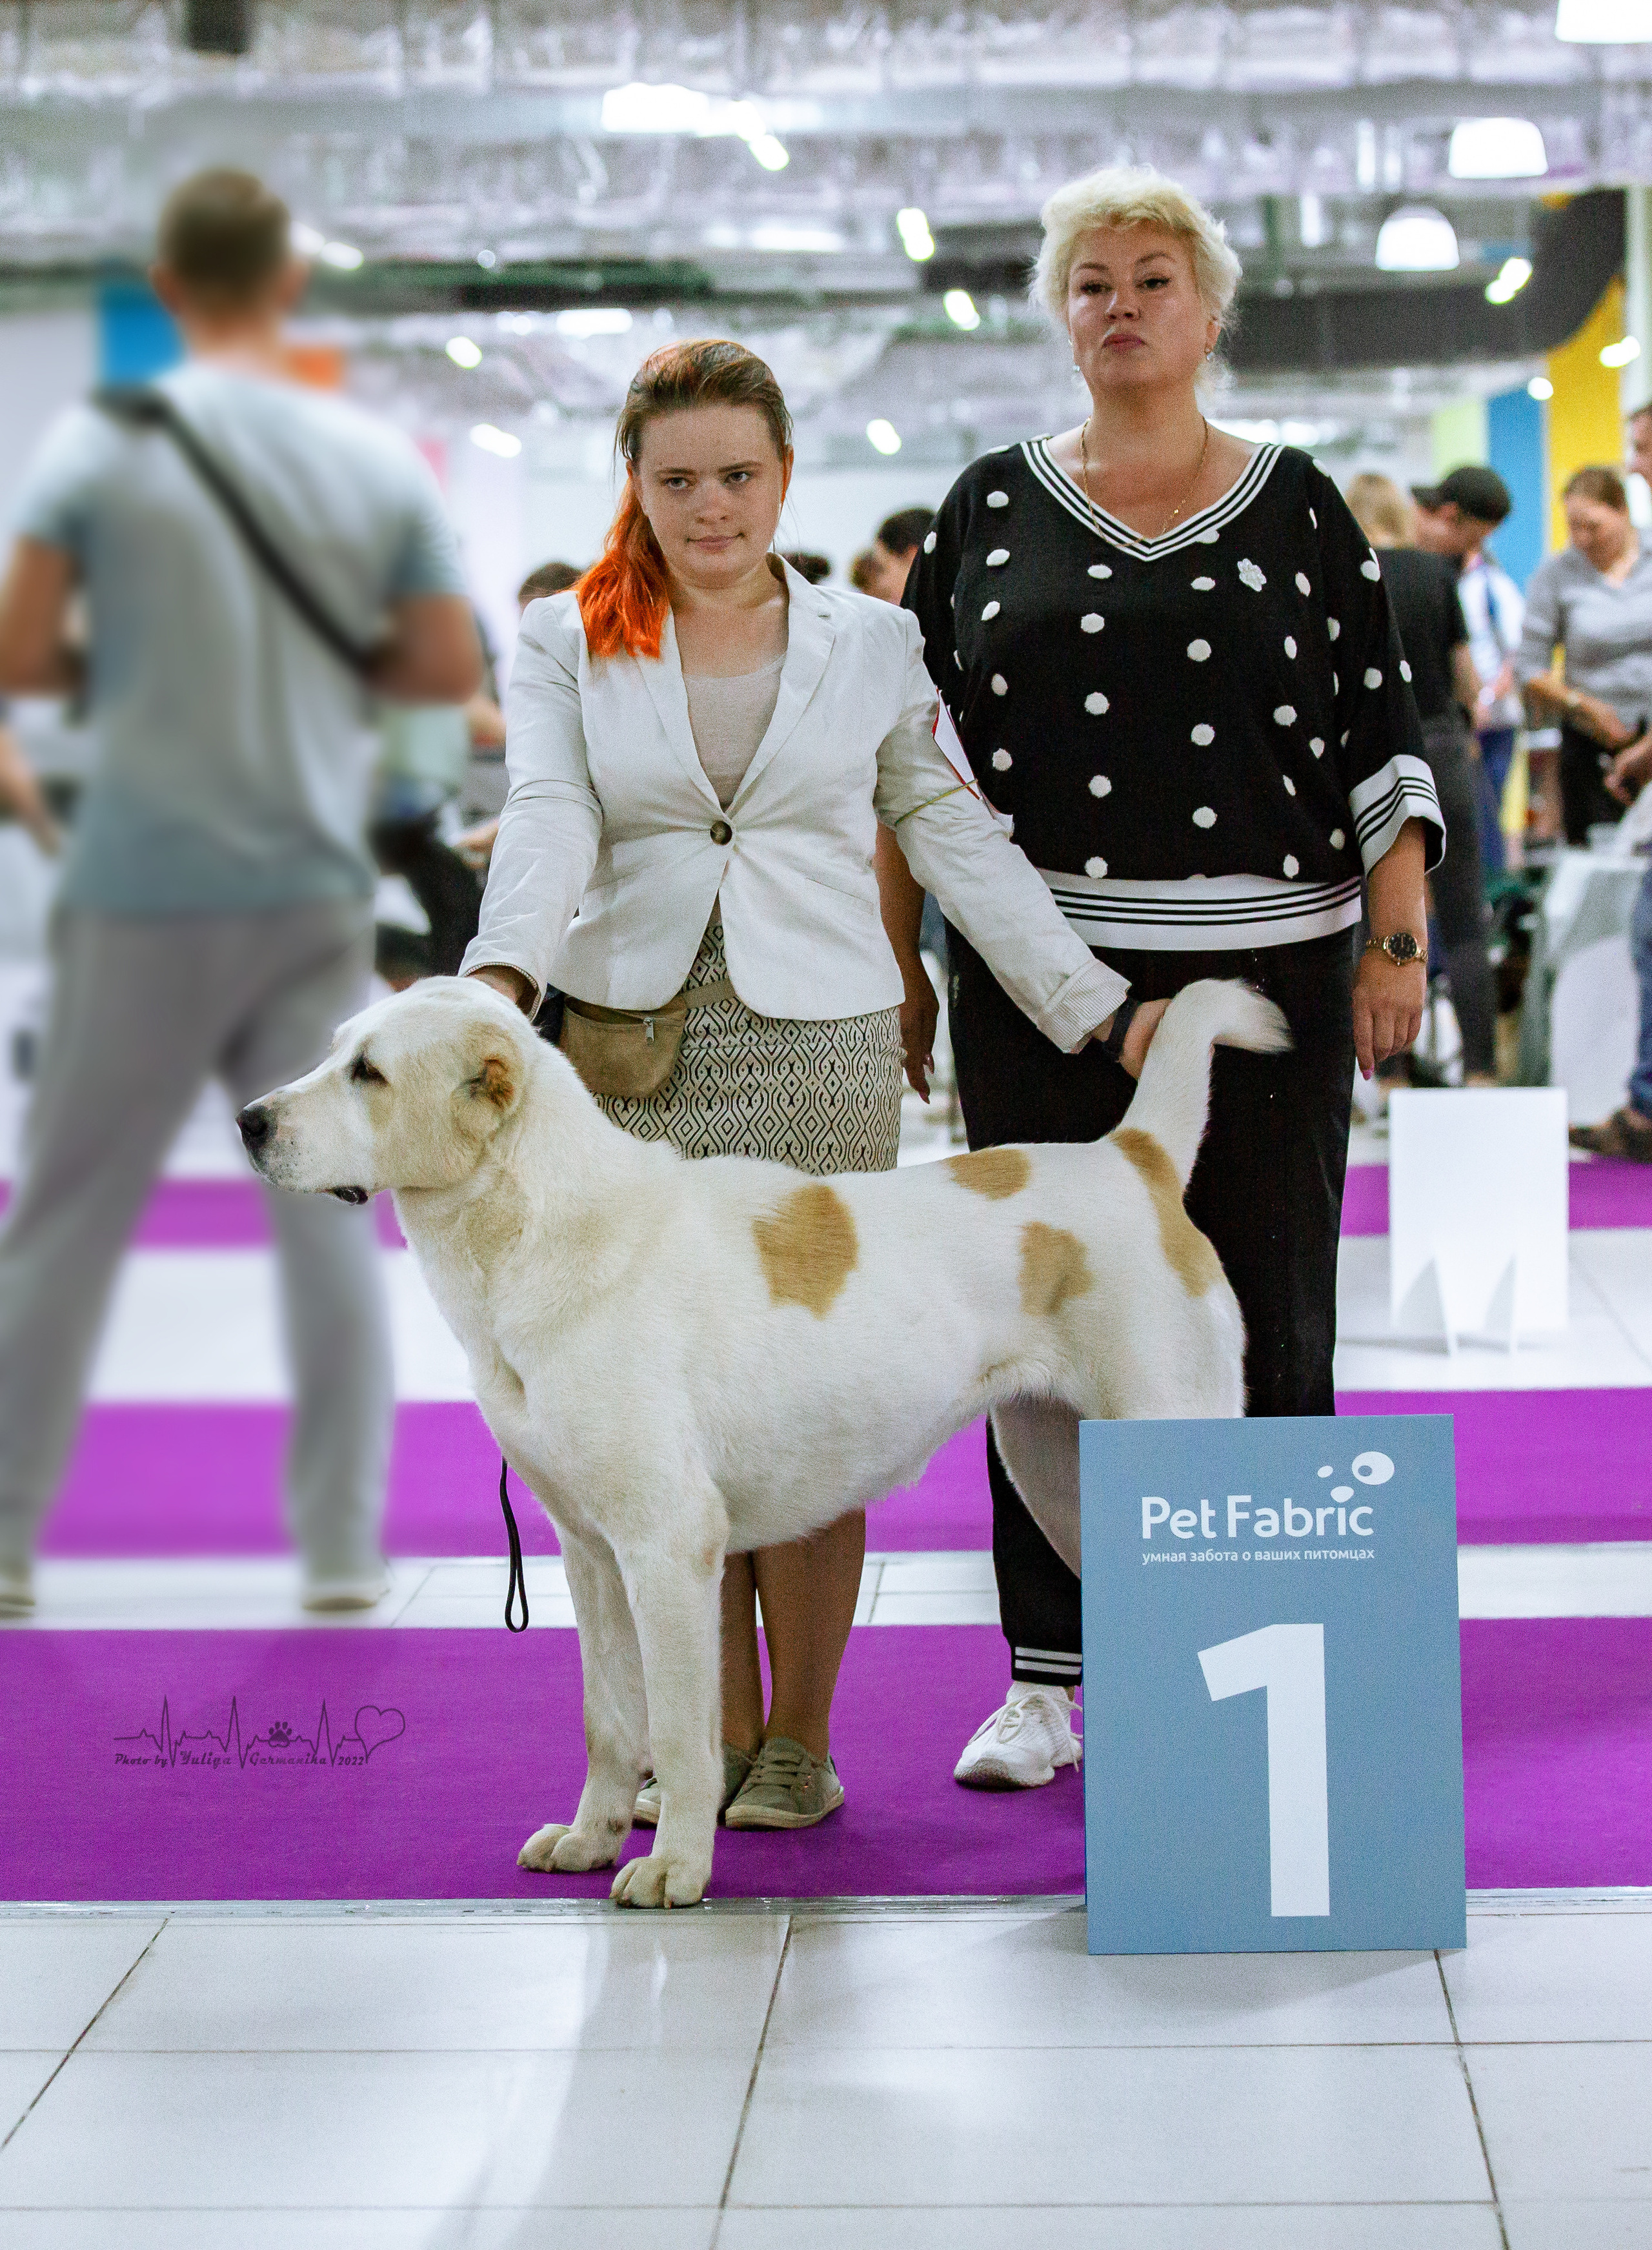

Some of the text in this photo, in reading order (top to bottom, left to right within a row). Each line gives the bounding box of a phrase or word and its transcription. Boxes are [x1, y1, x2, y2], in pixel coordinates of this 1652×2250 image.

[1142, 1486, 1375, 1539] Pet Fabric
[1142, 1549, 1375, 1565] умная забота о ваших питомцах
[1197, 1623, 1330, 1917] 1
